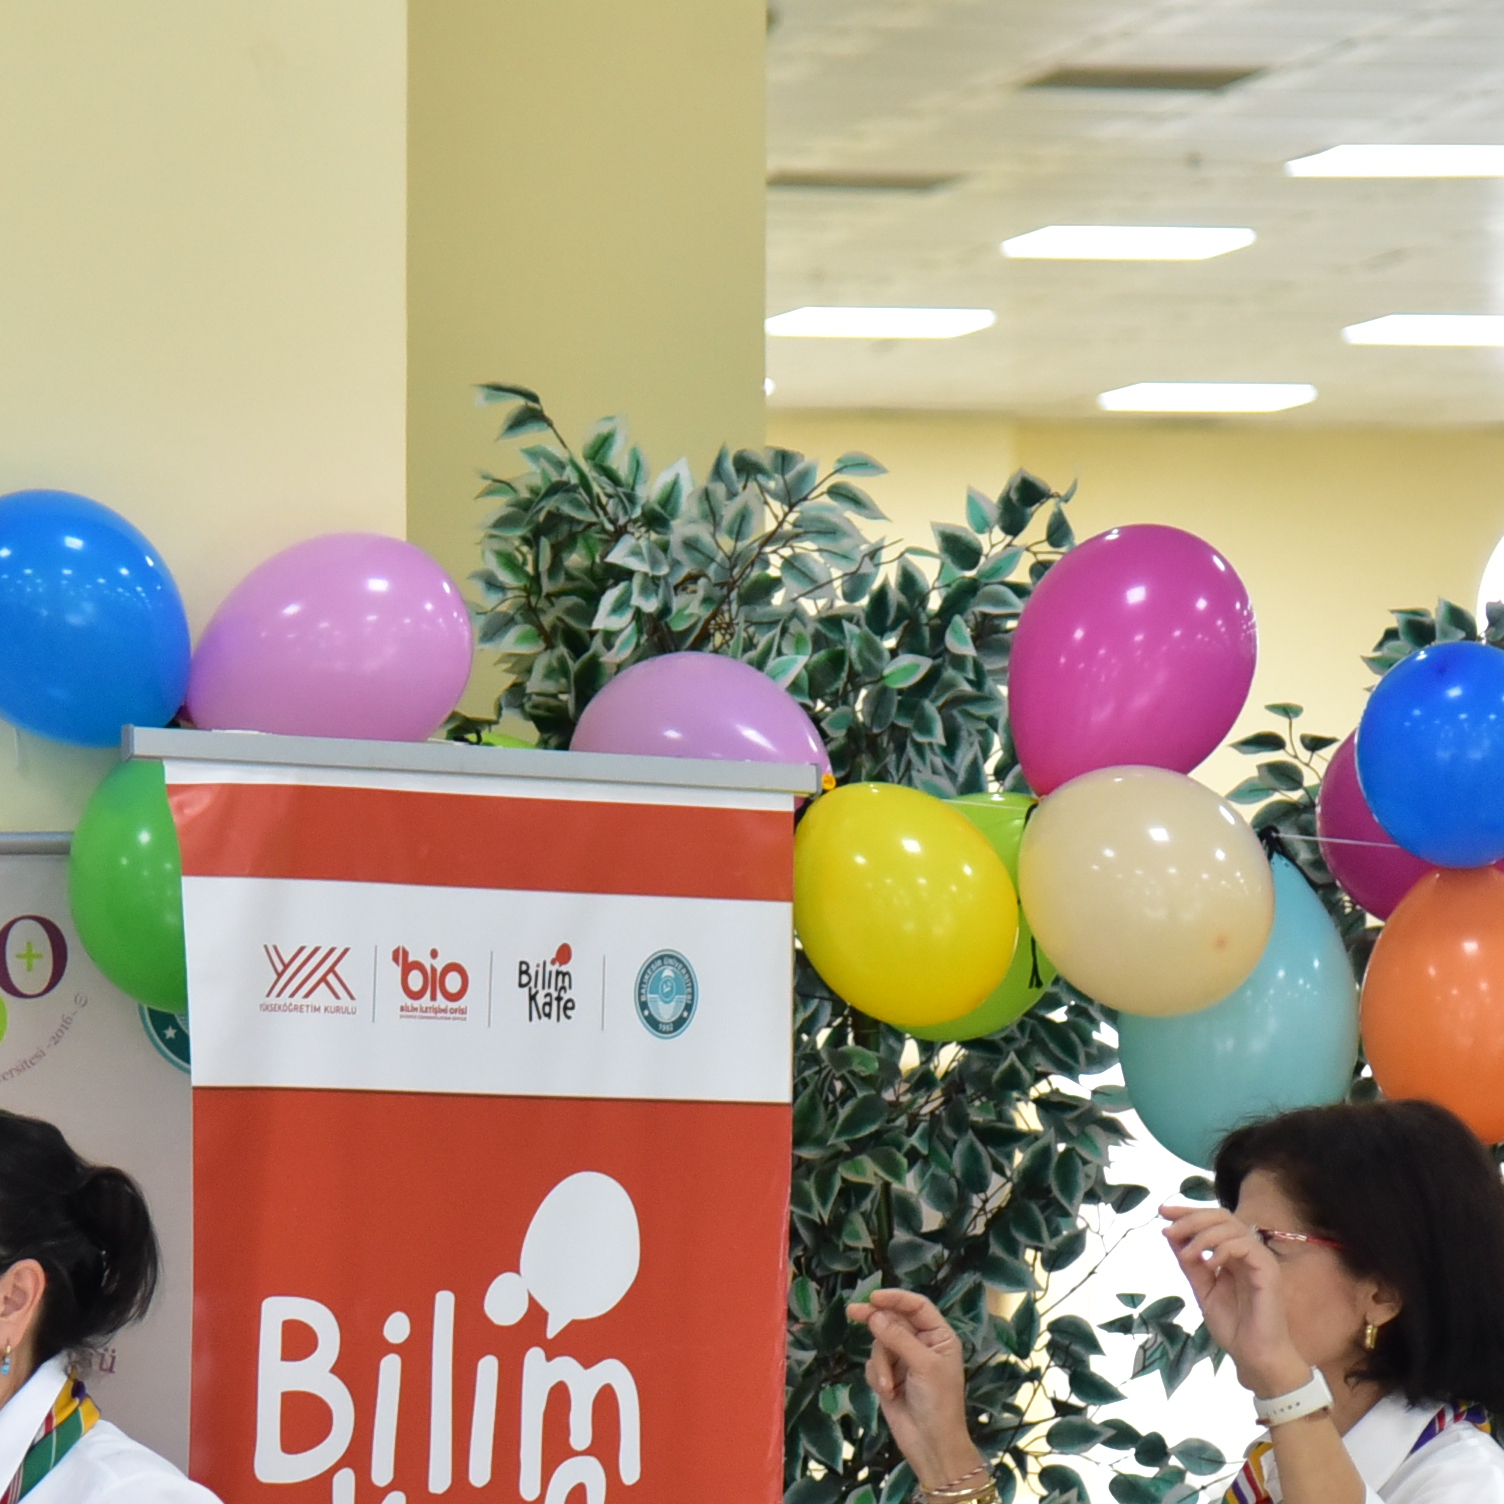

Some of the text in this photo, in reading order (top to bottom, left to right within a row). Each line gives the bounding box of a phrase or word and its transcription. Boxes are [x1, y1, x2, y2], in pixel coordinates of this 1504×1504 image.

[392, 945, 469, 1002] bio
[518, 958, 573, 992] Bilim
[323, 1005, 358, 1015] KURULU
[528, 985, 575, 1023] Kafe
[253, 1272, 642, 1501] Bilim
